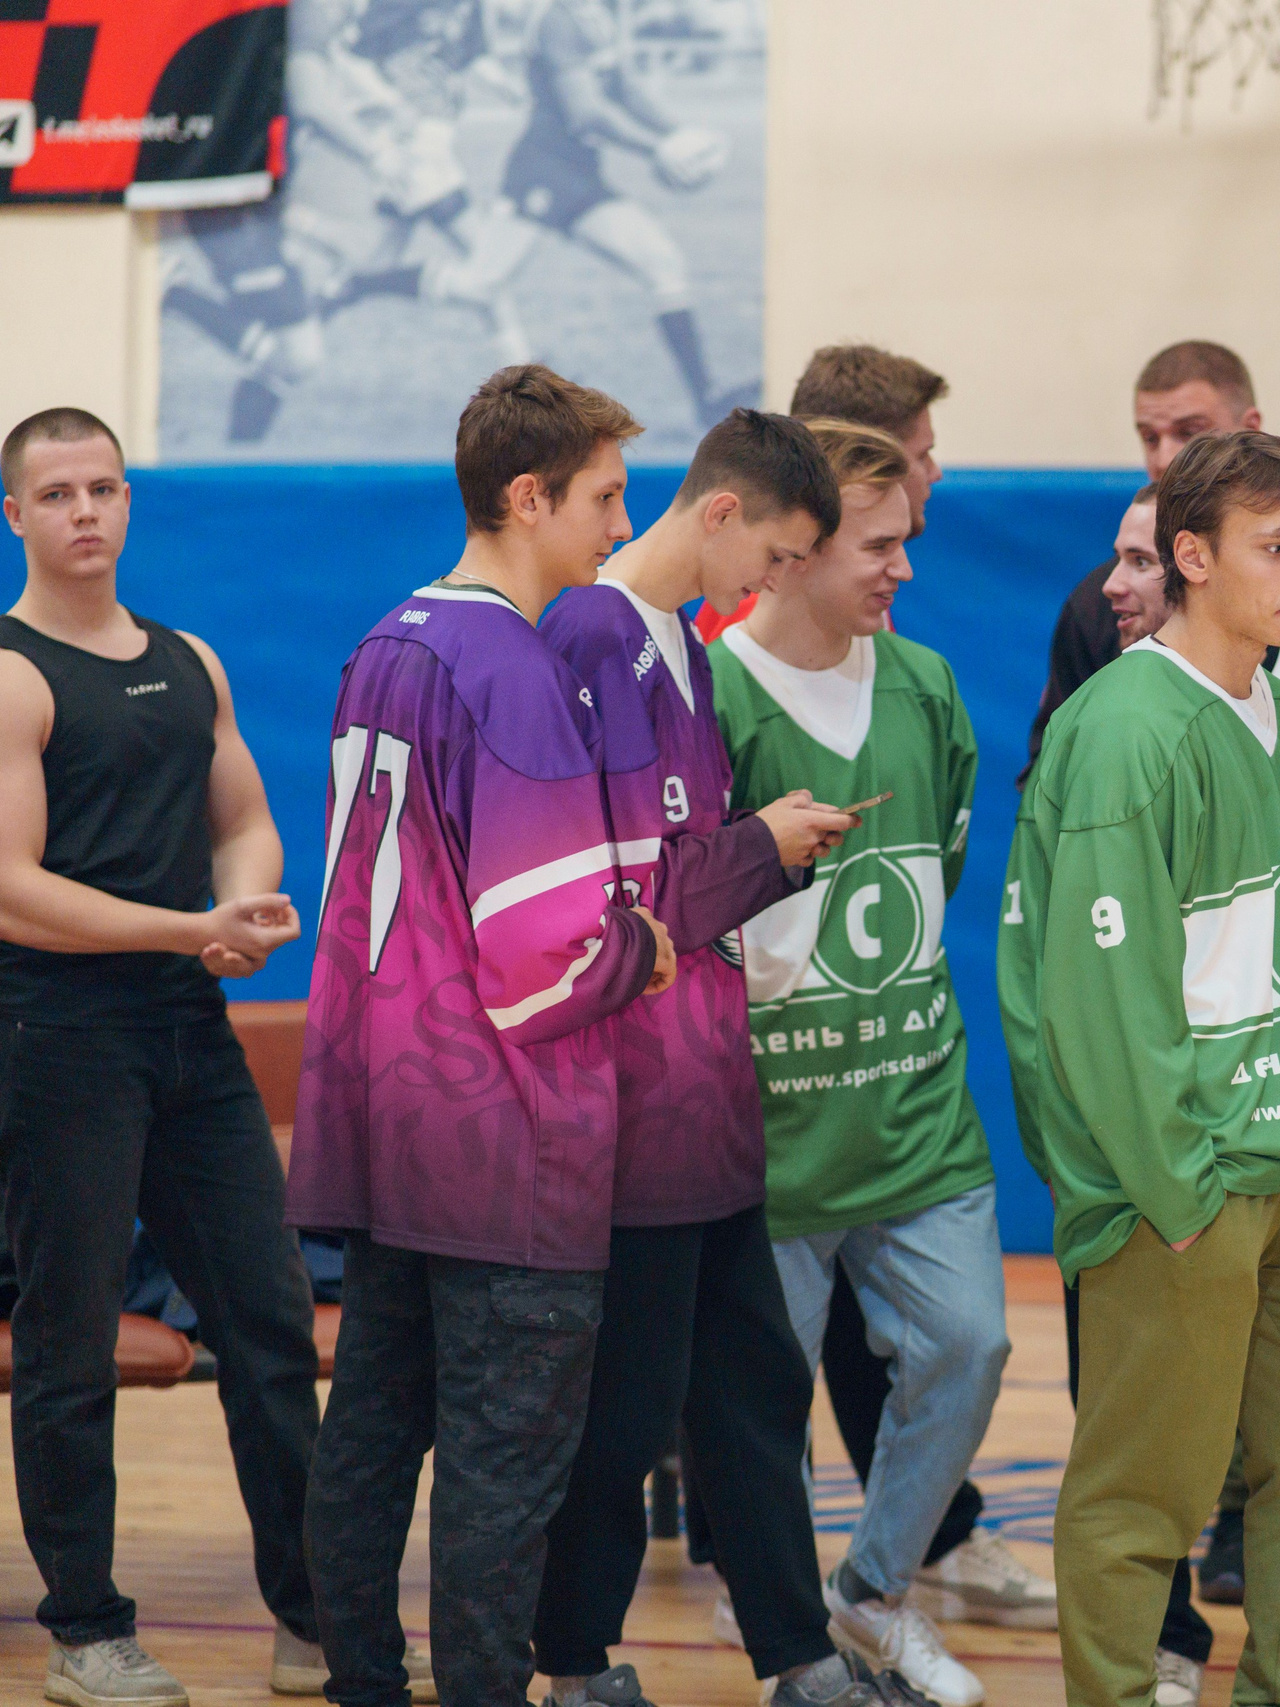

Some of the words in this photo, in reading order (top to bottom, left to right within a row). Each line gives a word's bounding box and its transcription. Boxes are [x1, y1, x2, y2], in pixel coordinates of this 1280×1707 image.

[124, 680, 168, 697] TARMAK
[662, 775, 691, 823] 9
[1091, 895, 1126, 949] 9
